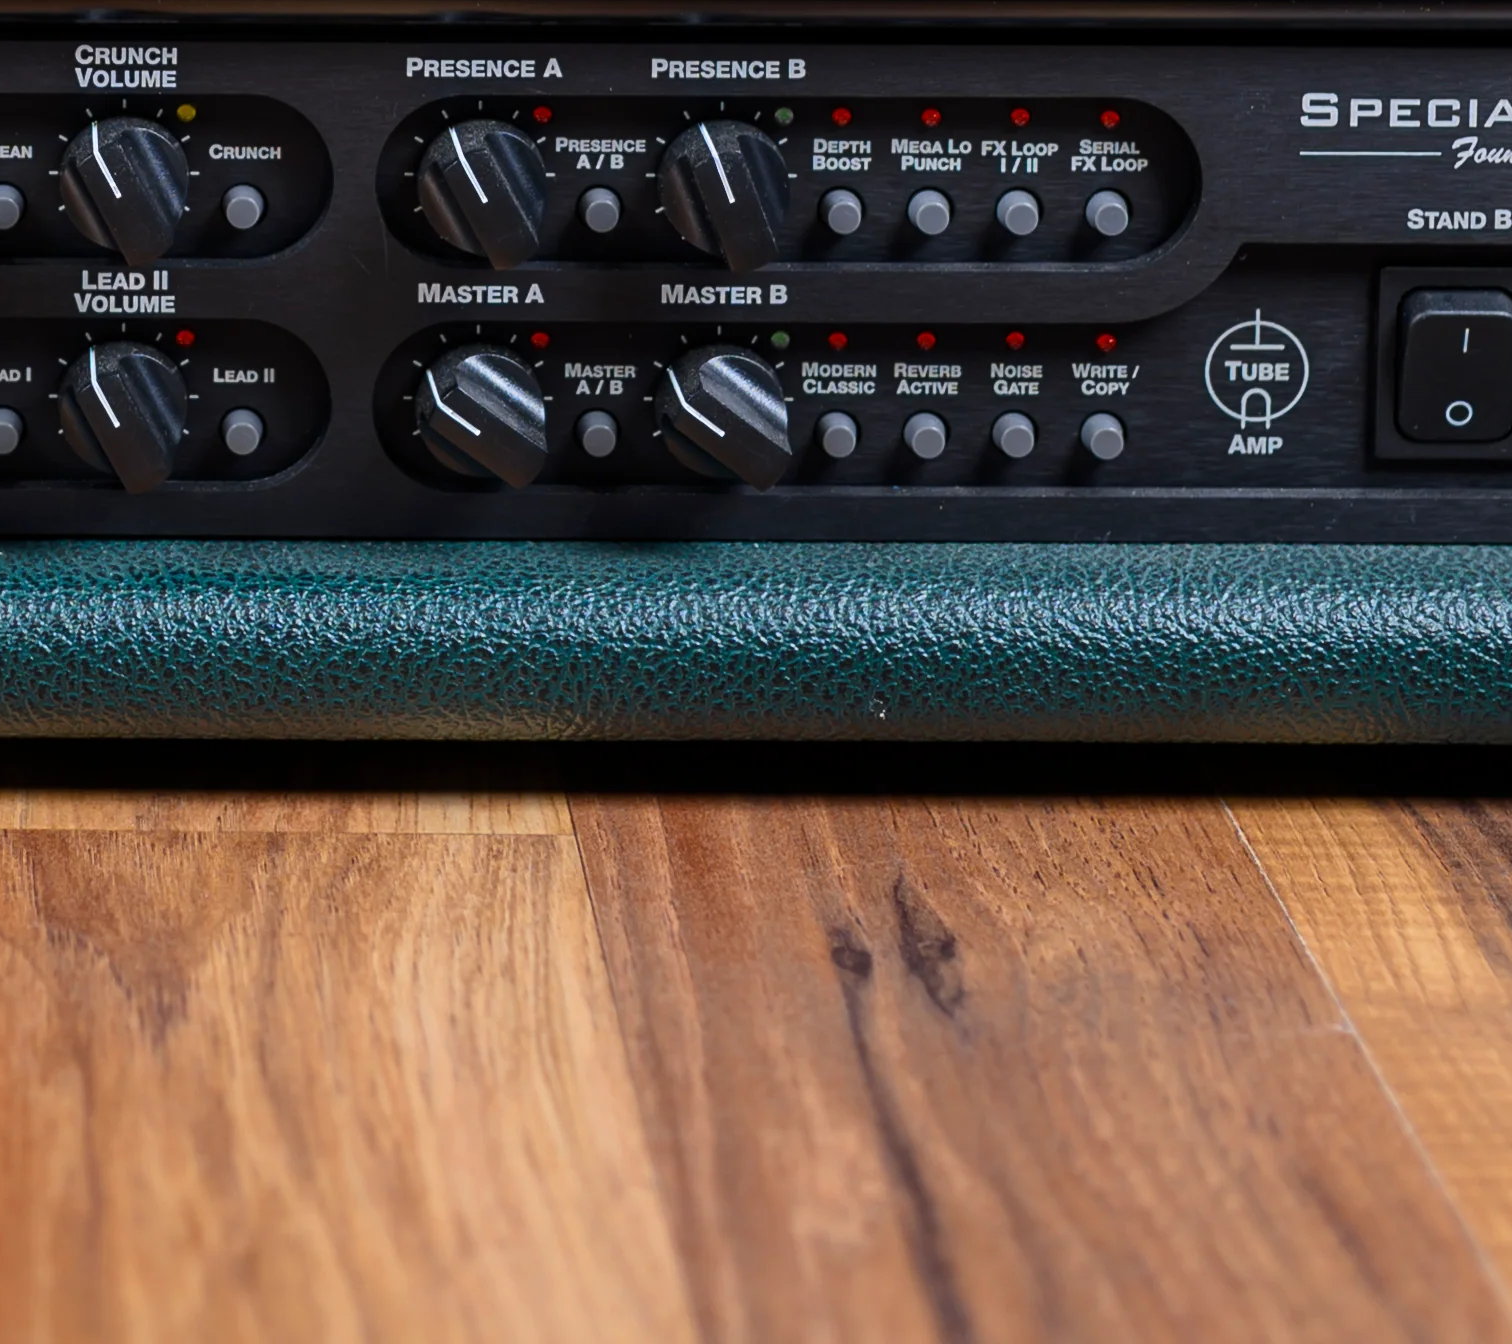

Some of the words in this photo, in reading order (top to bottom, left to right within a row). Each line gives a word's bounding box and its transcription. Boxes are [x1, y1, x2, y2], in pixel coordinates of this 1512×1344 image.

[74, 44, 178, 66] CRUNCH
[406, 57, 536, 78] PRESENCE
[651, 58, 781, 79] PRESENCE
[74, 67, 177, 88] VOLUME
[208, 143, 282, 160] CRUNCH
[555, 136, 647, 153] PRESENCE
[813, 138, 872, 154] DEPTH
[890, 138, 944, 155] MEGA
[947, 138, 973, 155] LO
[980, 140, 1007, 157] FX
[1010, 140, 1059, 159] LOOP
[1079, 138, 1140, 155] SERIAL
[812, 154, 872, 171] BOOST
[900, 155, 962, 172] PUNCH
[1070, 155, 1097, 172] FX
[1100, 155, 1149, 172] LOOP
[1406, 208, 1487, 230] STAND
[81, 269, 146, 291] LEAD
[417, 282, 519, 304] MASTER
[661, 284, 763, 305] MASTER
[73, 292, 176, 314] VOLUME
[212, 367, 259, 384] LEAD
[564, 362, 636, 379] MASTER
[801, 361, 877, 378] MODERN
[893, 362, 962, 378] REVERB
[990, 363, 1043, 379] NOISE
[1071, 363, 1128, 379] WRITE
[1224, 360, 1290, 382] TUBE
[802, 378, 876, 395] CLASSIC
[896, 379, 959, 395] ACTIVE
[993, 379, 1039, 396] GATE
[1080, 379, 1130, 396] COPY
[1227, 433, 1284, 455] AMP
